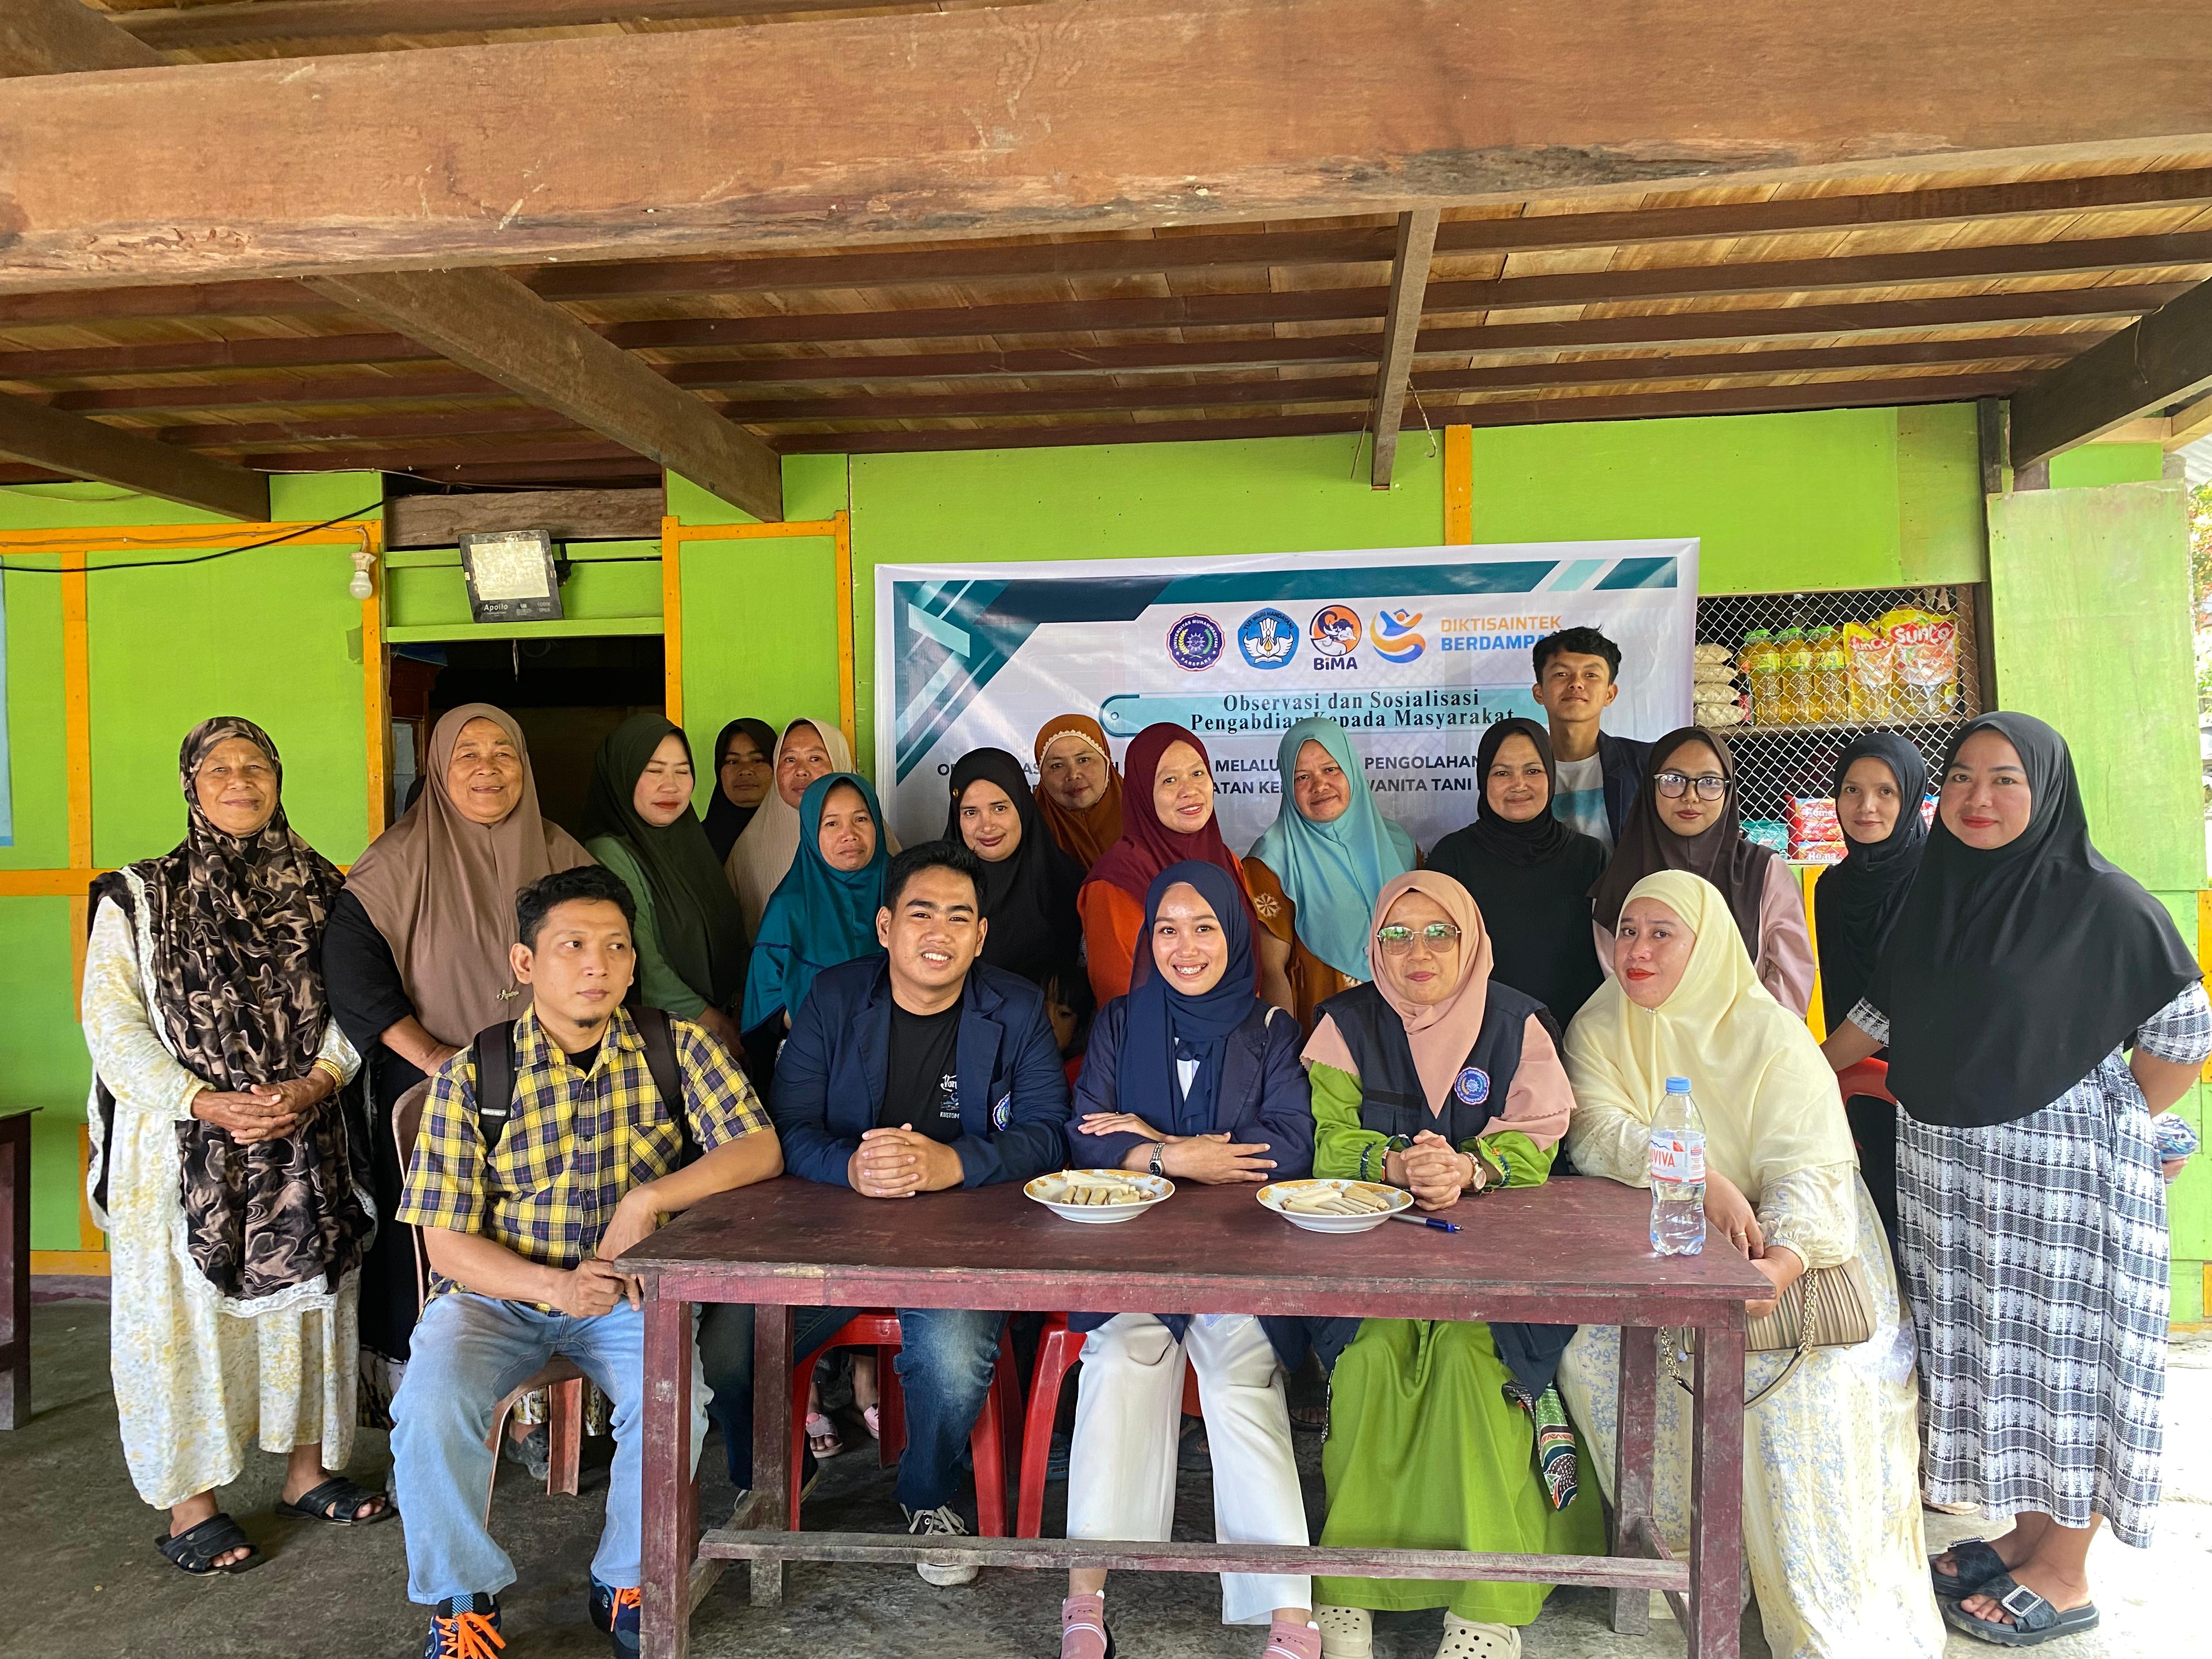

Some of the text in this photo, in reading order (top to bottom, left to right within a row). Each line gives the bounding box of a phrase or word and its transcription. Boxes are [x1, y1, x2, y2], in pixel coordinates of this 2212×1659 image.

[483, 603, 508, 612] Apollo
[1244, 618, 1253, 630] TUT
[1267, 611, 1294, 630] HANDAYANI
[1441, 615, 1562, 632] DIKTISAINTEK
[1173, 619, 1218, 649] UNIVERSITAS MUHAMMADIYAH
[1441, 634, 1545, 651] BERDAMP
[1181, 656, 1211, 666] PAREPARE
[1223, 689, 1479, 712] Observasi dan Sosialisasi
[1395, 708, 1514, 730] Masyarakat
[1215, 759, 1279, 772] MELALU
[1431, 778, 1471, 791] TANI
